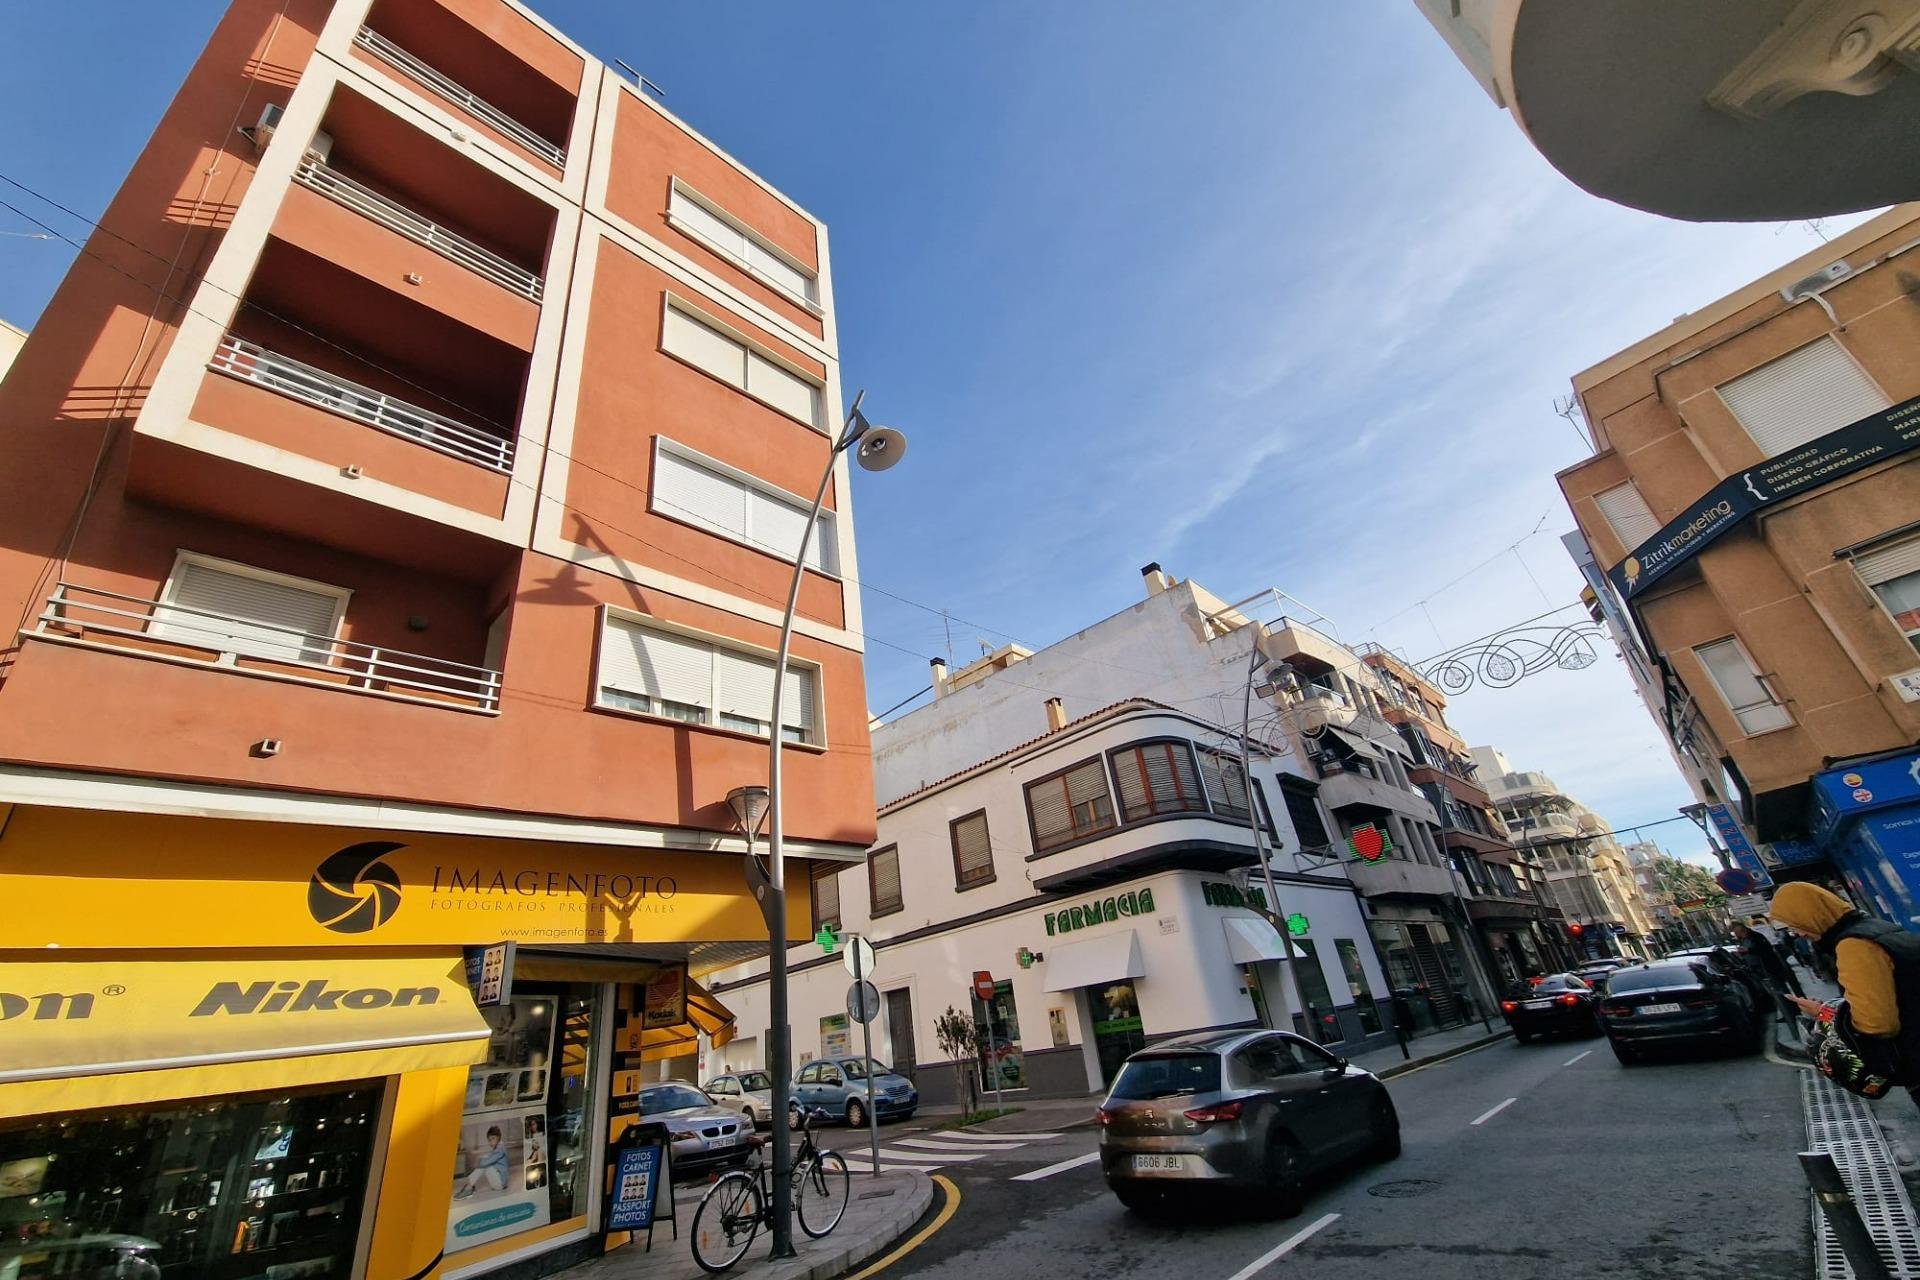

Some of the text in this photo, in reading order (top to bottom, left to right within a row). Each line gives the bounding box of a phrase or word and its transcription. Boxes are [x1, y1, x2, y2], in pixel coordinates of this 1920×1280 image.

[1760, 448, 1819, 476] PUBLICIDAD
[1805, 447, 1849, 468] GRÁFICO
[1773, 445, 1885, 493] IMAGEN CORPORATIVA
[432, 865, 677, 899] IMAGENFOTO
[1201, 880, 1269, 910] FARMAIA
[559, 902, 675, 914] PROFESIONALES
[1044, 887, 1155, 936] FARMACIA
[500, 927, 609, 938] www.imagenfoto.es
[187, 979, 441, 1017] Nikon
[626, 1151, 652, 1162] FOTOS
[1163, 1156, 1180, 1168] JBL
[623, 1161, 652, 1173] CARNET
[613, 1200, 652, 1213] PASSPORT
[613, 1210, 647, 1223] PHOTOS
